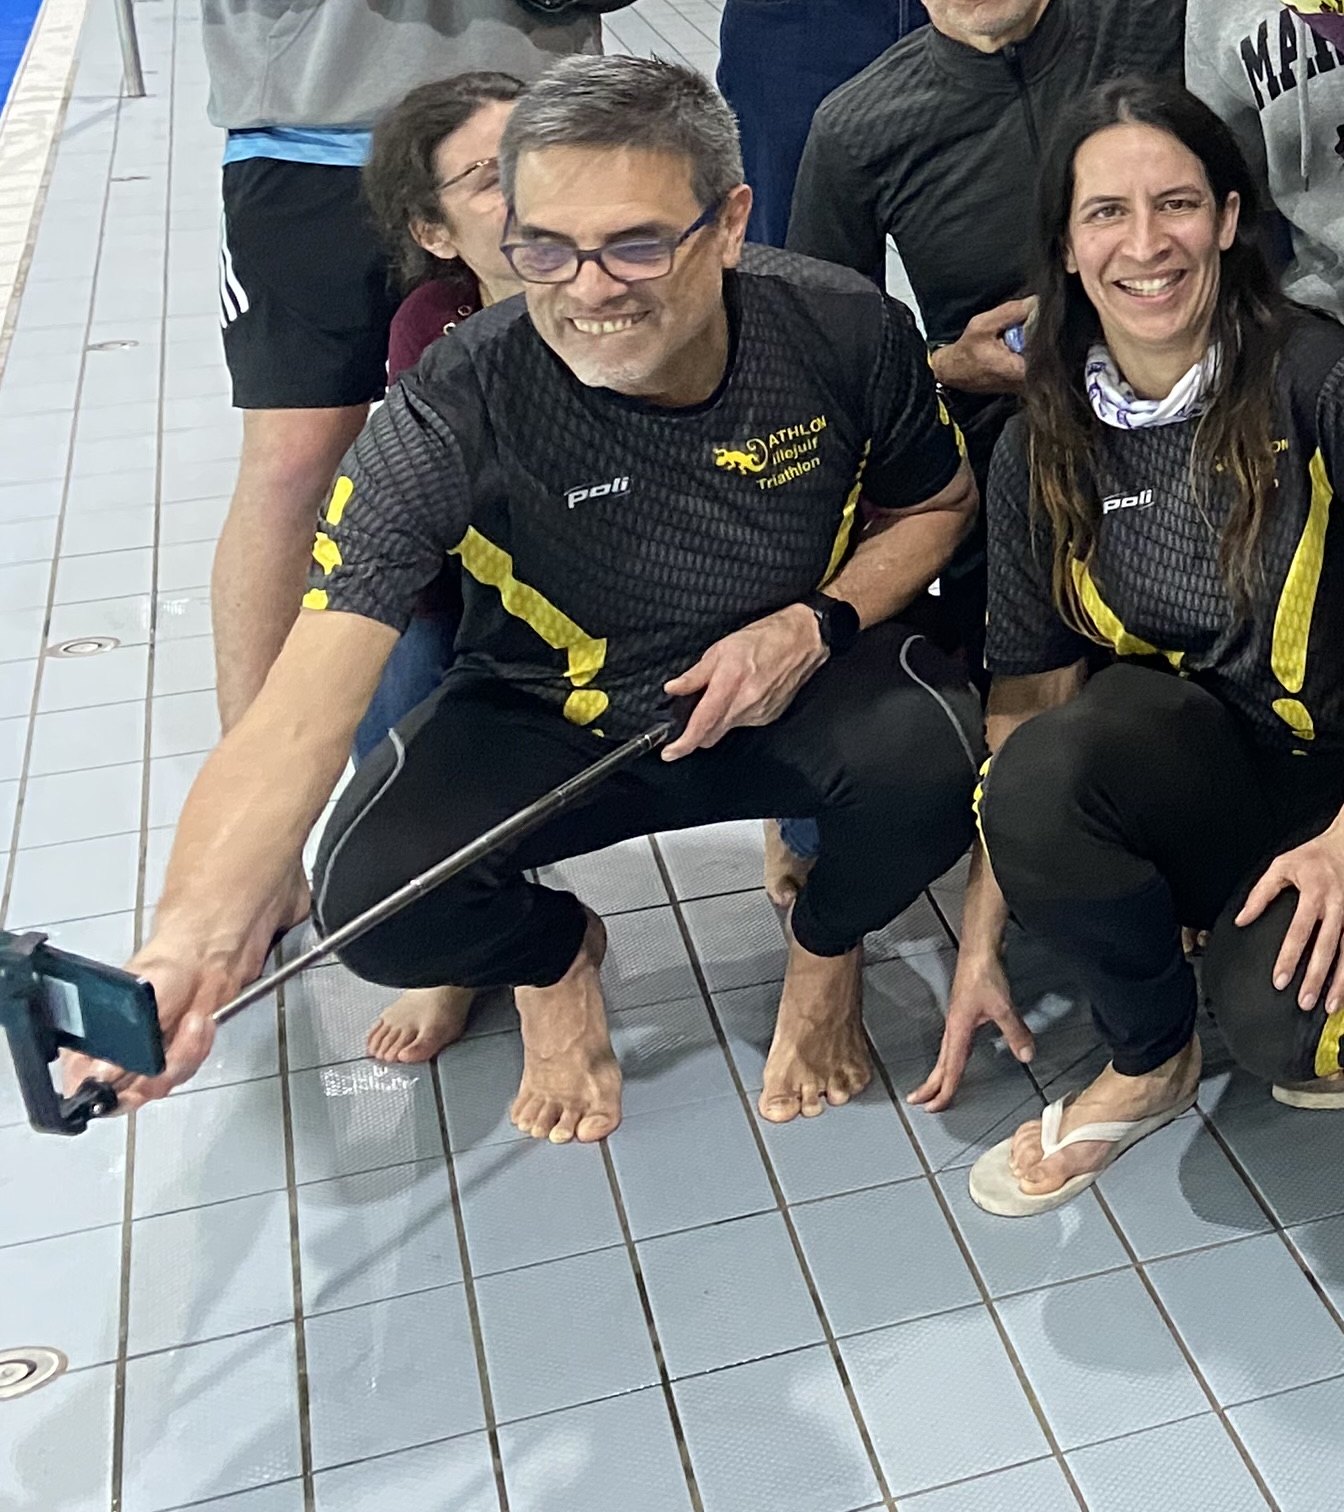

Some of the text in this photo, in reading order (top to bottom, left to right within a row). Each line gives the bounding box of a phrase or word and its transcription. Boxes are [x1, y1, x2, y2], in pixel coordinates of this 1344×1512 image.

[768, 414, 828, 449] ATHLON
[756, 454, 821, 491] Triathlon
[1103, 489, 1153, 515] poli
